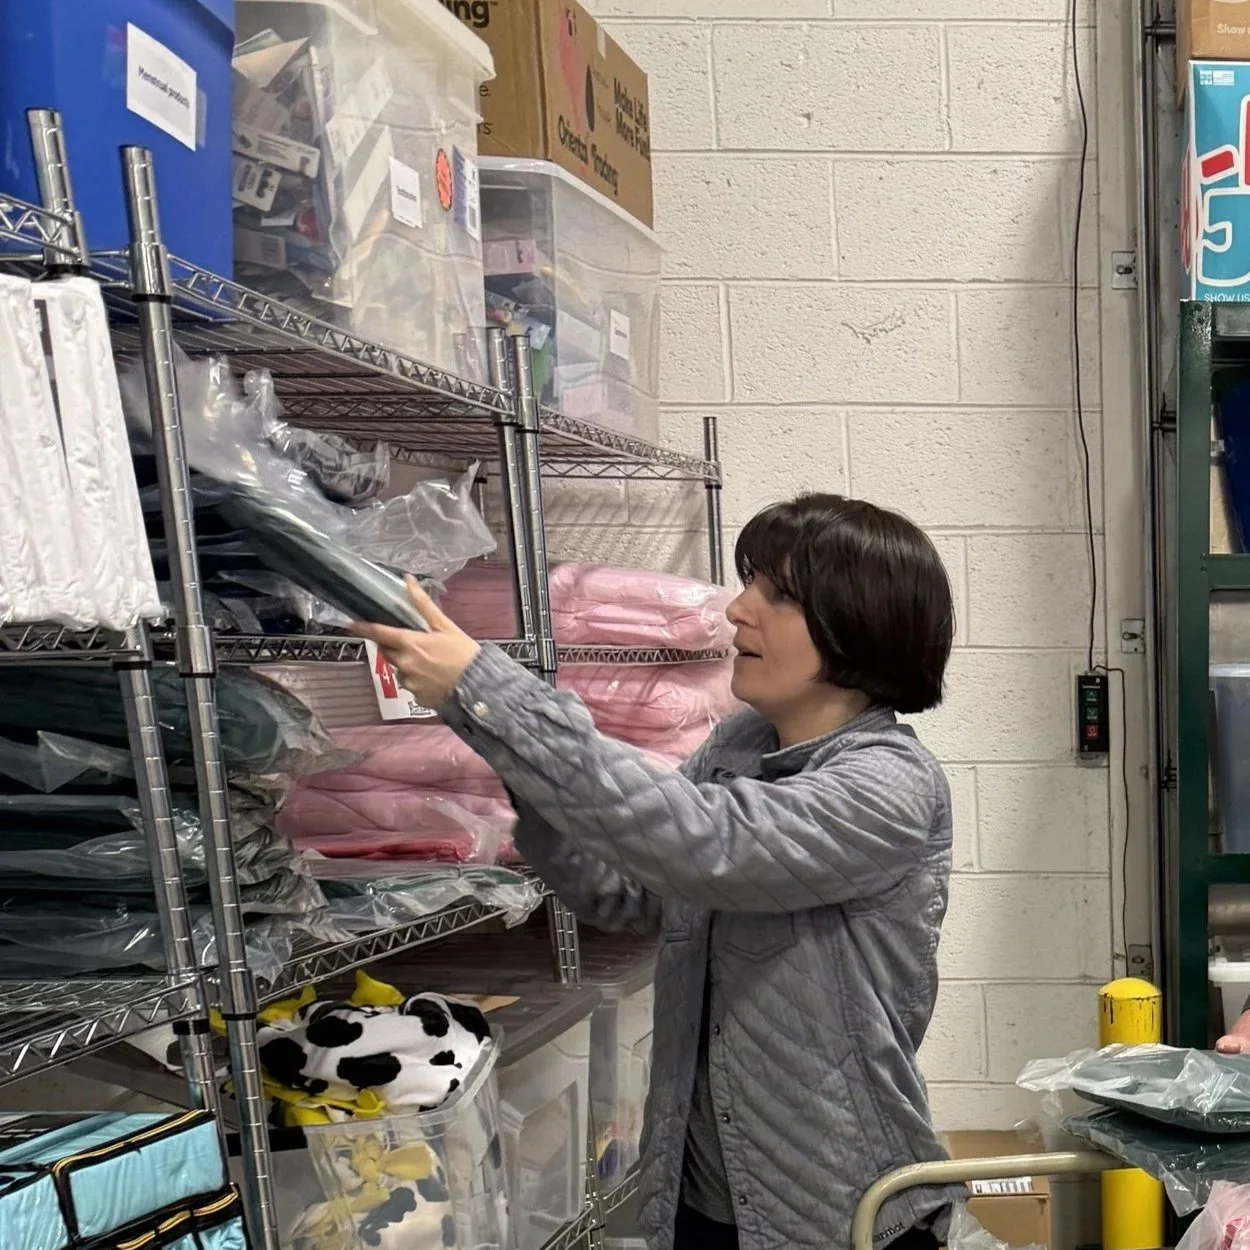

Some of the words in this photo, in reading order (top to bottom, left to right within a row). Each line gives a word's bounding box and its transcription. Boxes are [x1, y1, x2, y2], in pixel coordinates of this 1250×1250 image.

[1216, 23, 1245, 35] Show
[1204, 293, 1235, 302] SHOW
[1238, 293, 1250, 302] US
